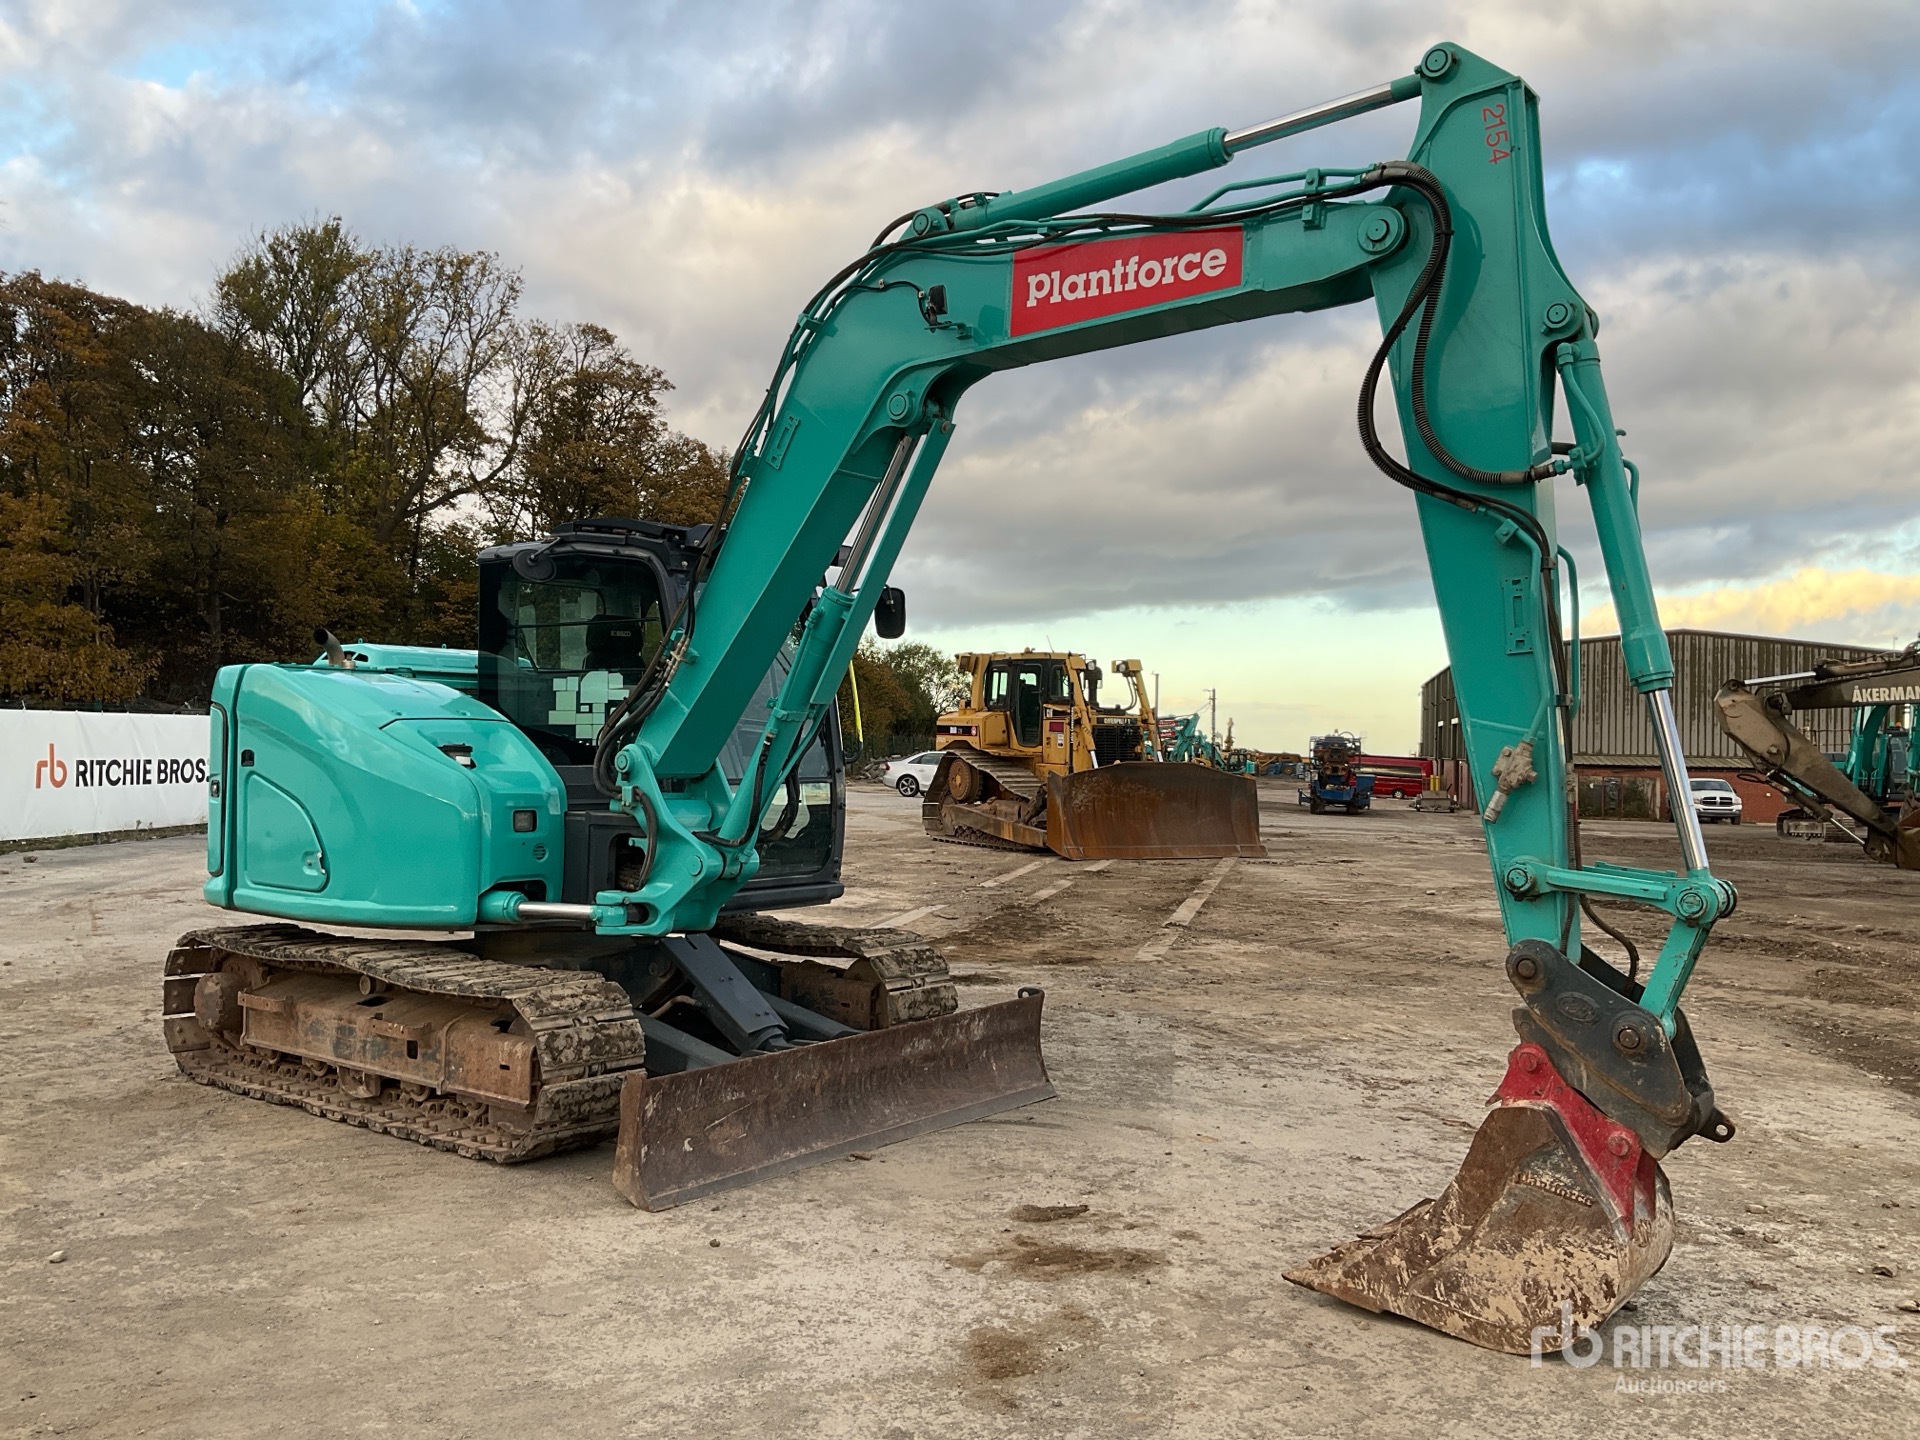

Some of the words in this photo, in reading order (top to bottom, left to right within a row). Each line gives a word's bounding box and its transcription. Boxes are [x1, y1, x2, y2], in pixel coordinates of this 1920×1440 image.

[1482, 103, 1511, 164] 2154
[1026, 248, 1228, 308] plantforce
[75, 758, 152, 787] RITCHIE
